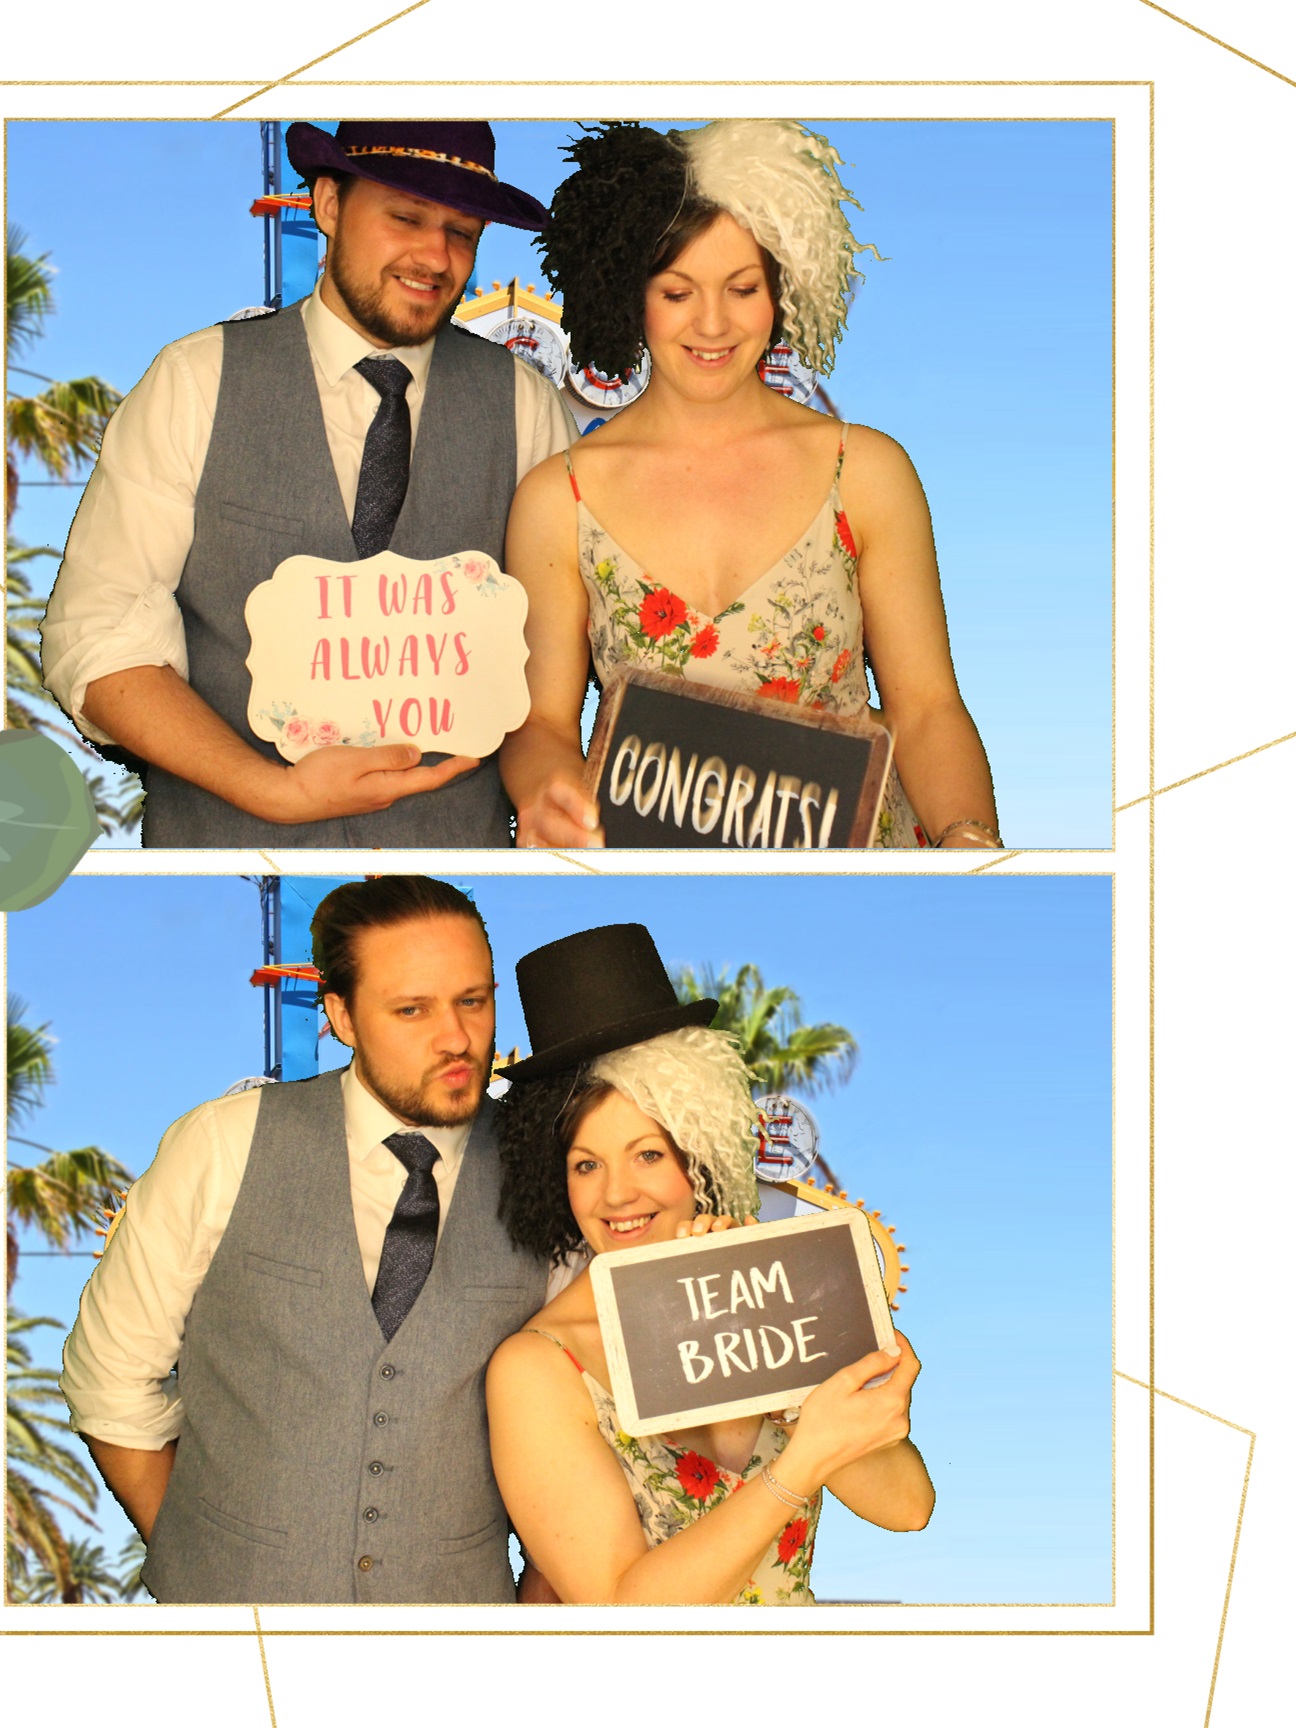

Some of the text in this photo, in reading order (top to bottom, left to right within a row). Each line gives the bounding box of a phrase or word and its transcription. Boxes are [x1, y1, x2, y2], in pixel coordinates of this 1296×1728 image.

[315, 571, 459, 619] IT WAS
[310, 631, 472, 681] ALWAYS
[372, 697, 454, 738] YOU
[609, 734, 839, 848] CONGRATS!
[677, 1260, 794, 1321] TEAM
[677, 1316, 828, 1384] BRIDE
